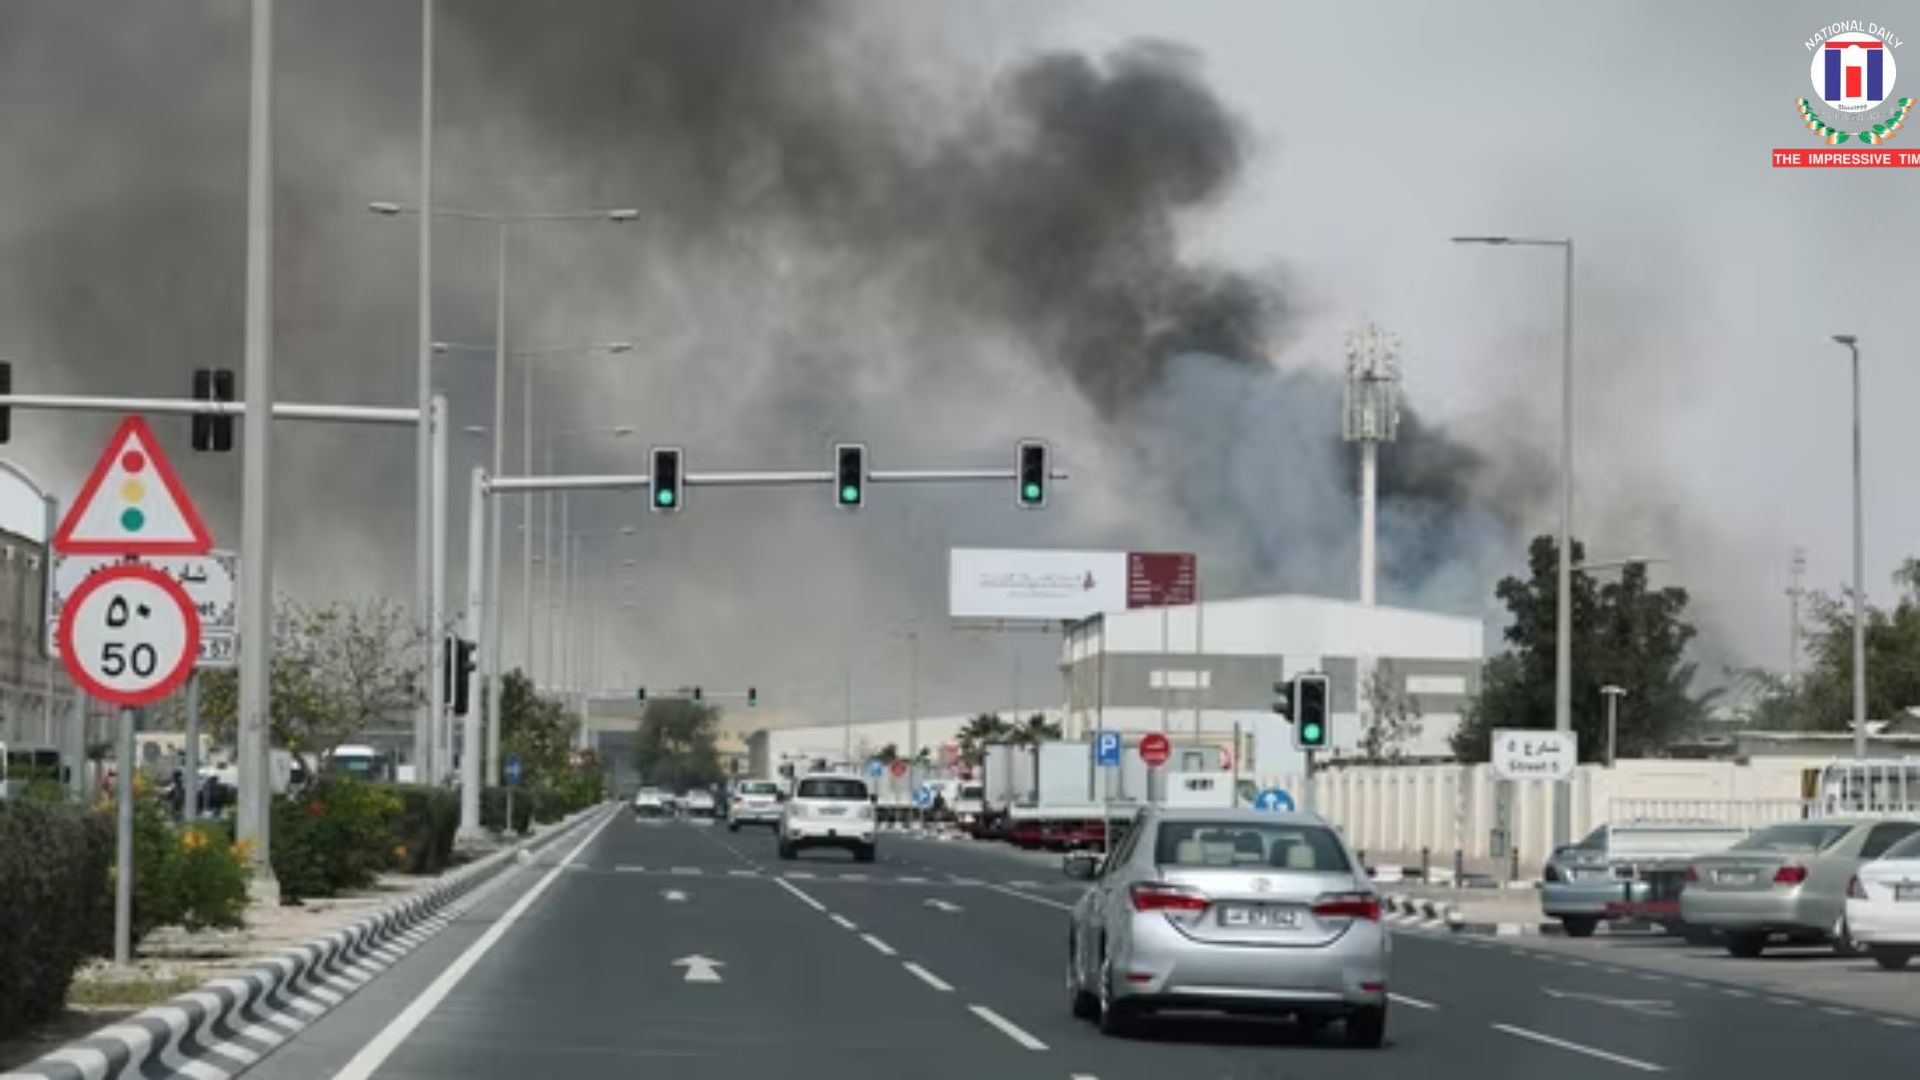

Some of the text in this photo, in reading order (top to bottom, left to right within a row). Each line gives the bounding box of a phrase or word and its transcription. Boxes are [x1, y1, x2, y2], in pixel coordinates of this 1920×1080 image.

[106, 595, 152, 627] ٥٠
[101, 642, 157, 678] 50
[1100, 734, 1117, 756] P
